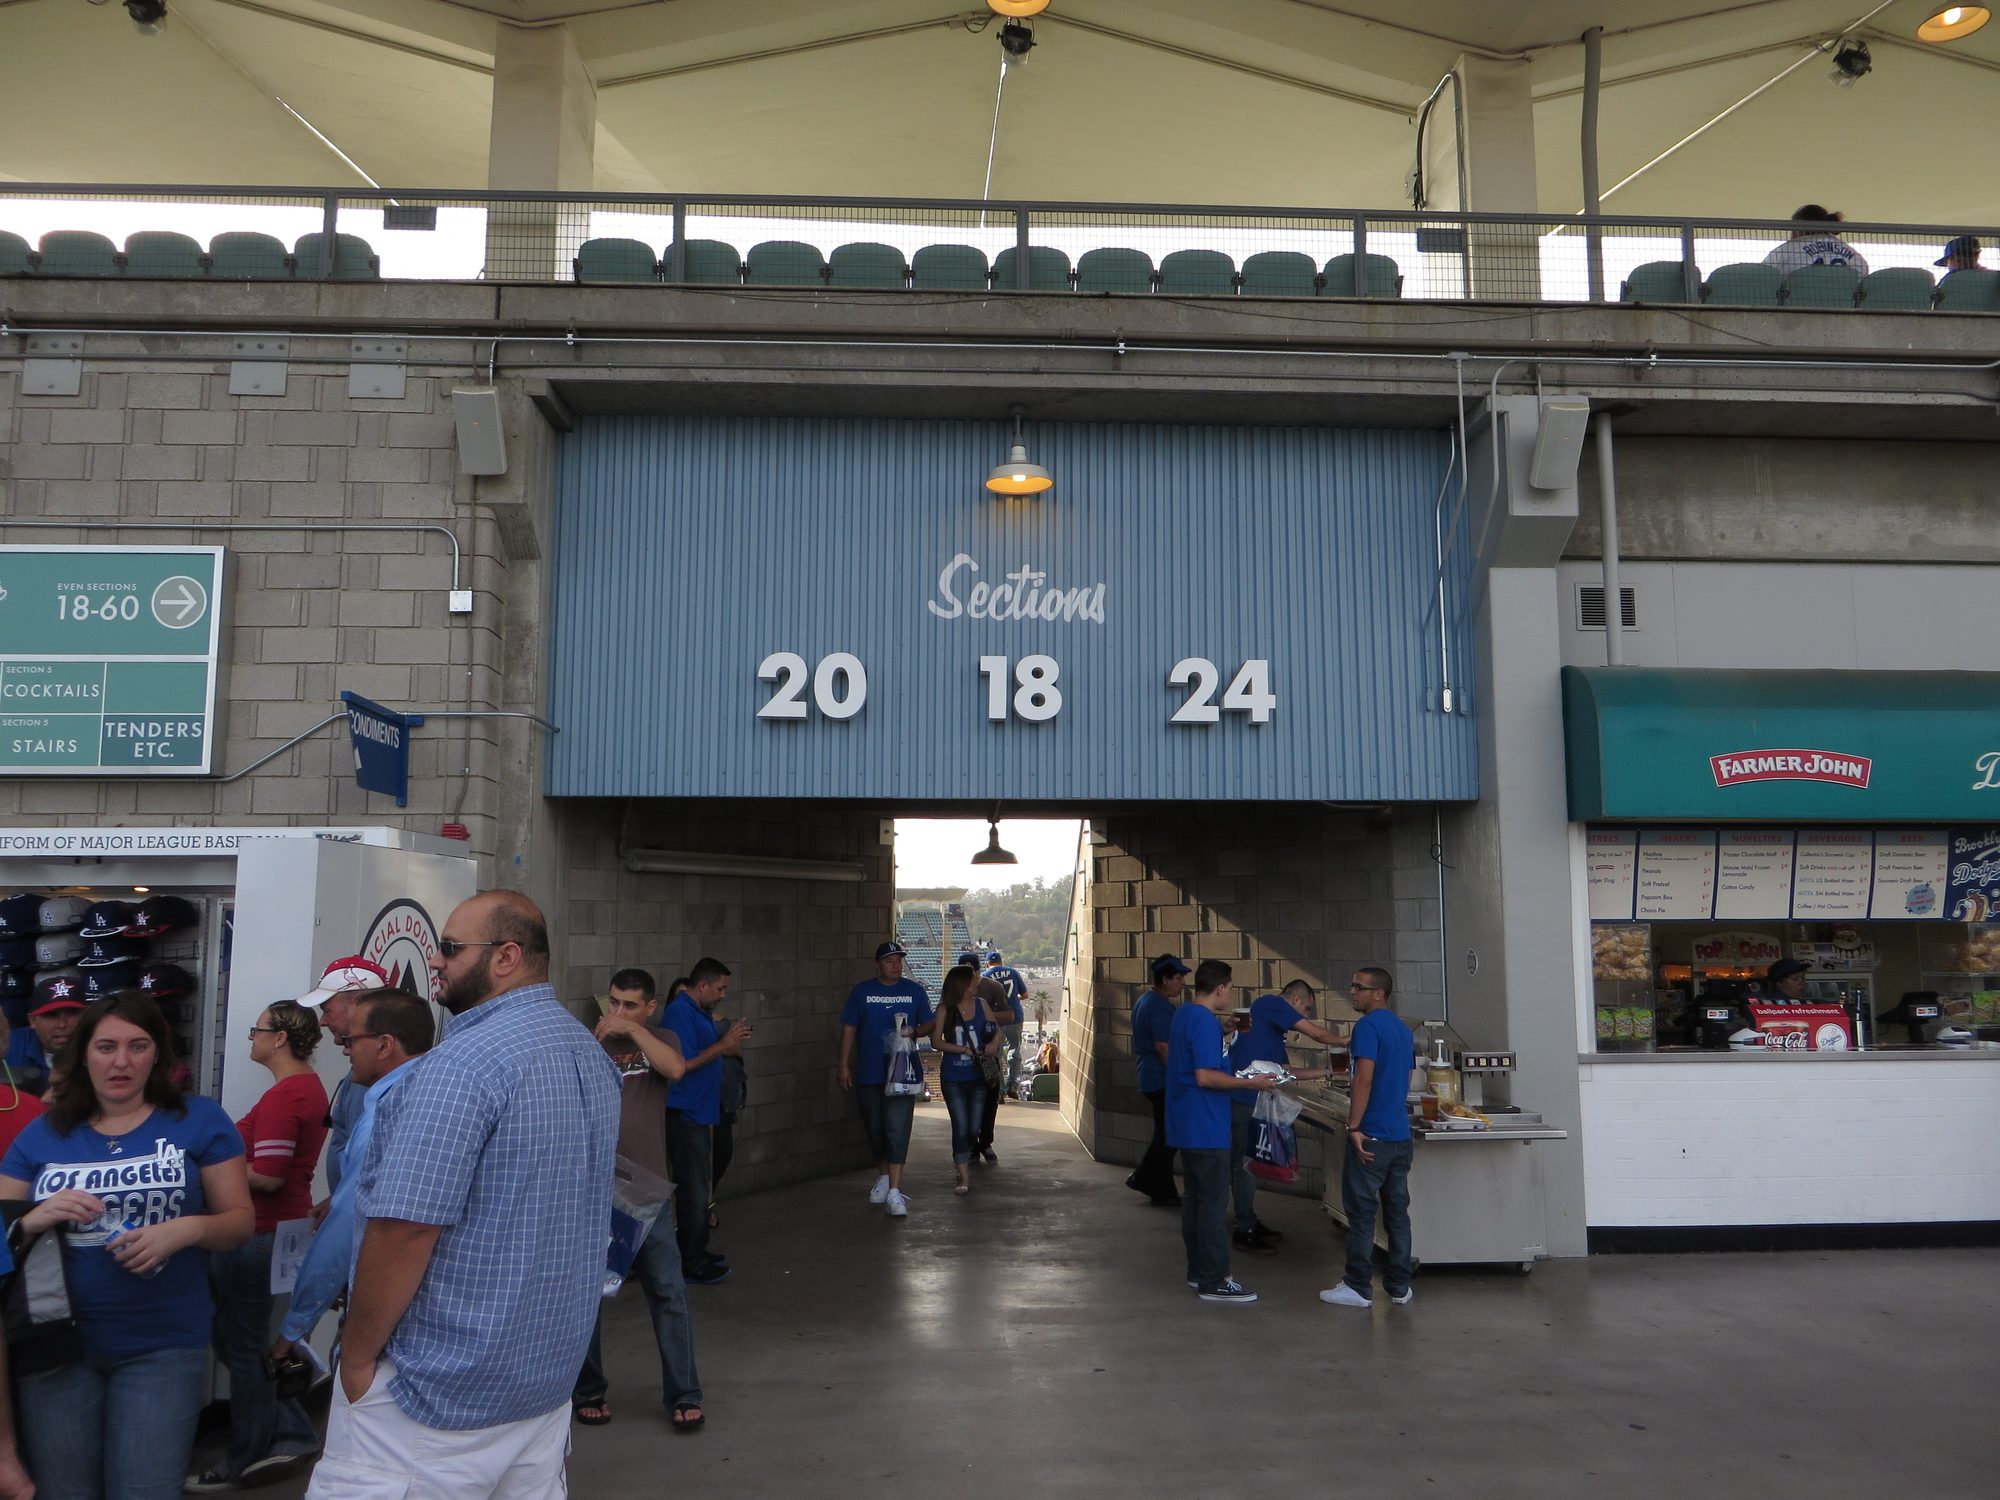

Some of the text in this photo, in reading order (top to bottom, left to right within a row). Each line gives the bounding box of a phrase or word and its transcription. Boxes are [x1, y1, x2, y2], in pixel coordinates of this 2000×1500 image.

[57, 583, 137, 591] EVEN SECTIONS
[928, 553, 1106, 624] Sections
[57, 595, 140, 621] 18-60
[6, 666, 45, 674] SECTION
[4, 684, 100, 698] COCKTAILS
[757, 652, 1276, 725] 20 18 24
[2, 719, 41, 727] SECTION
[105, 722, 202, 738] TENDERS
[12, 739, 77, 753] STAIRS
[134, 742, 175, 758] ETC.
[1718, 754, 1863, 779] FARMER JOHN
[53, 836, 76, 849] OF
[80, 836, 133, 850] MAJOR
[138, 836, 201, 849] LEAGUE
[1659, 834, 1697, 842] SNACKS
[1731, 834, 1783, 842] NOVELTIES
[1807, 834, 1862, 842] BEVERAGES
[1901, 834, 1924, 842] BEER
[1642, 867, 1662, 875] Peanuts
[866, 995, 913, 1004] DODGERTOWN
[38, 1162, 182, 1195] LOS ANGELES
